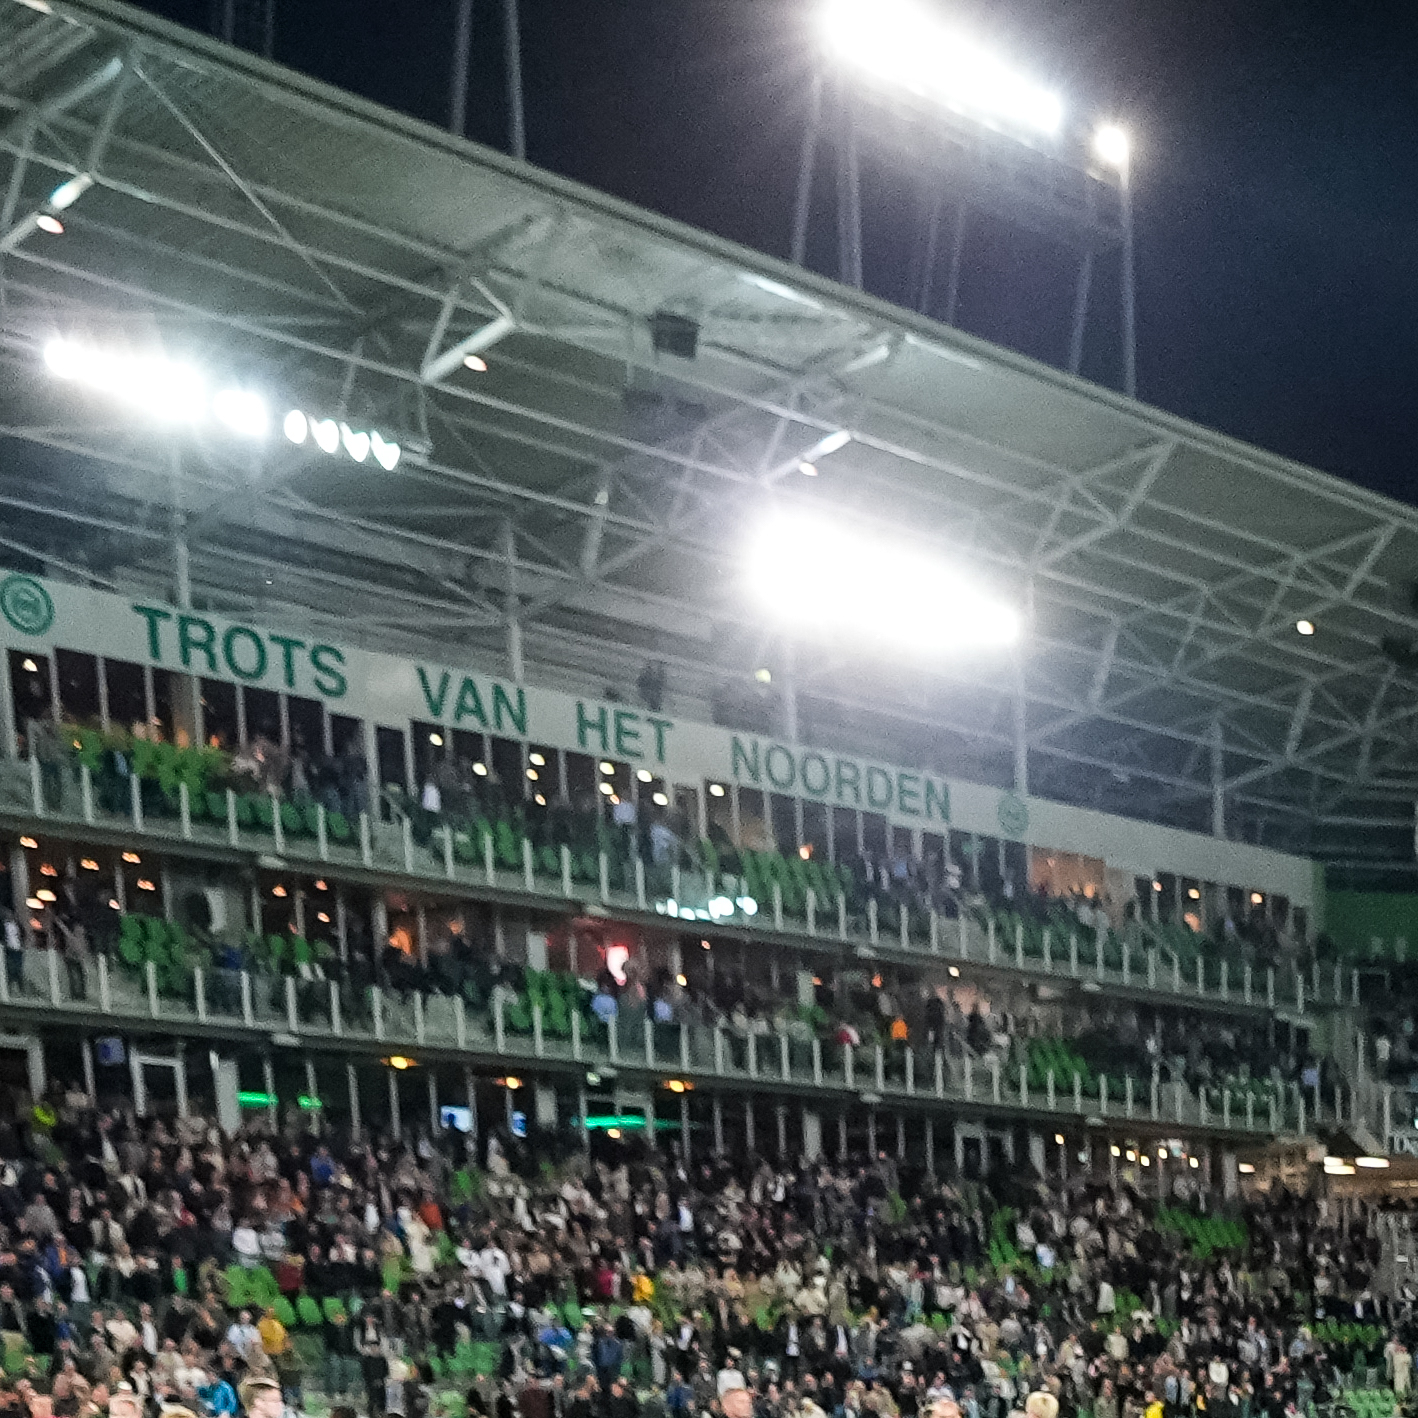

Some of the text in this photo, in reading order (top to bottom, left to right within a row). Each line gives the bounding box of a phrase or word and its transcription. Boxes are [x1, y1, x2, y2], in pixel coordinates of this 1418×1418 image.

[133, 603, 951, 822] TROTS VAN HET NOORDEN
